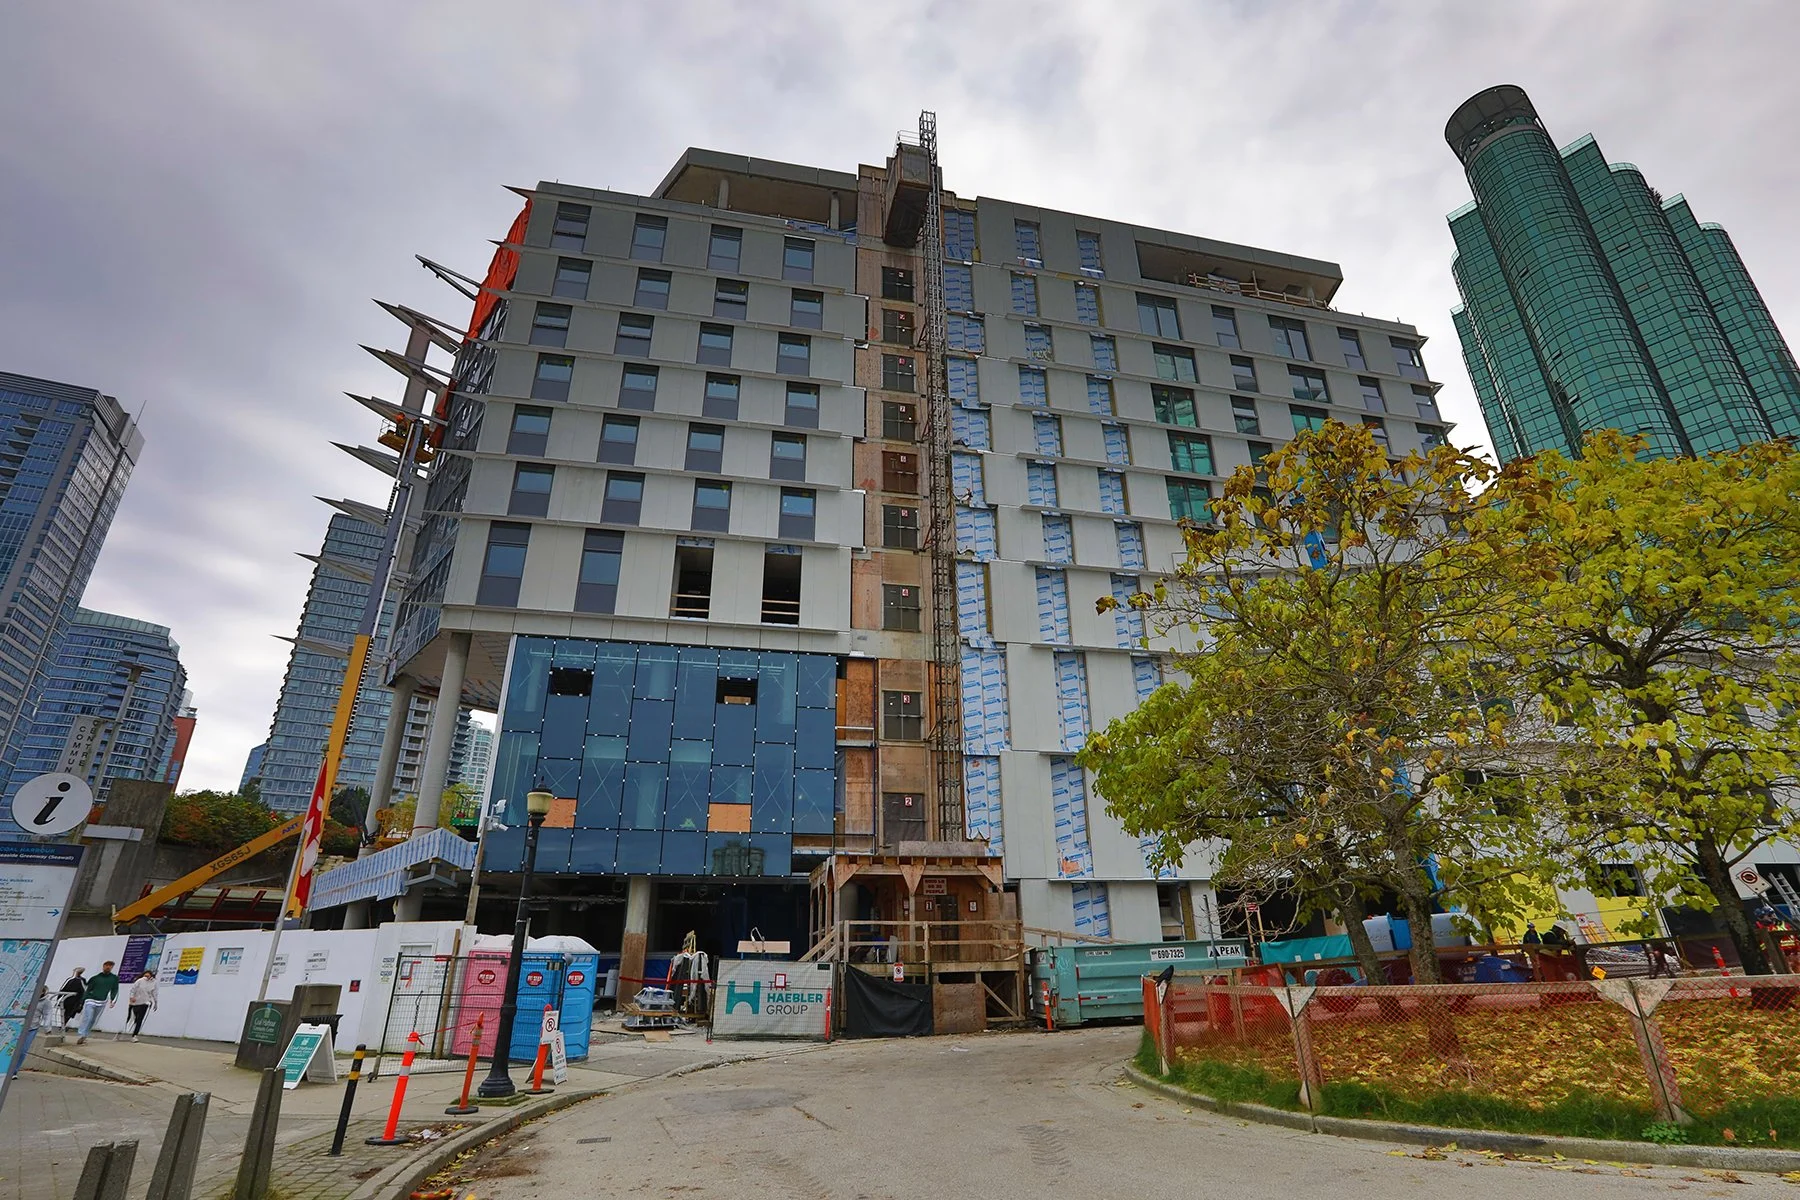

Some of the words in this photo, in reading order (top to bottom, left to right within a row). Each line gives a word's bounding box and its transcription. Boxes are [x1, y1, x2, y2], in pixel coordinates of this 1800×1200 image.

[78, 720, 100, 767] CENTRE
[64, 726, 87, 773] COMMUN
[209, 846, 251, 872] XGS65J
[1157, 948, 1185, 959] 690-7325
[1220, 946, 1241, 956] PEAK
[768, 980, 792, 991] TE
[767, 992, 823, 1003] HAEBLER
[766, 1004, 808, 1015] GROUP
